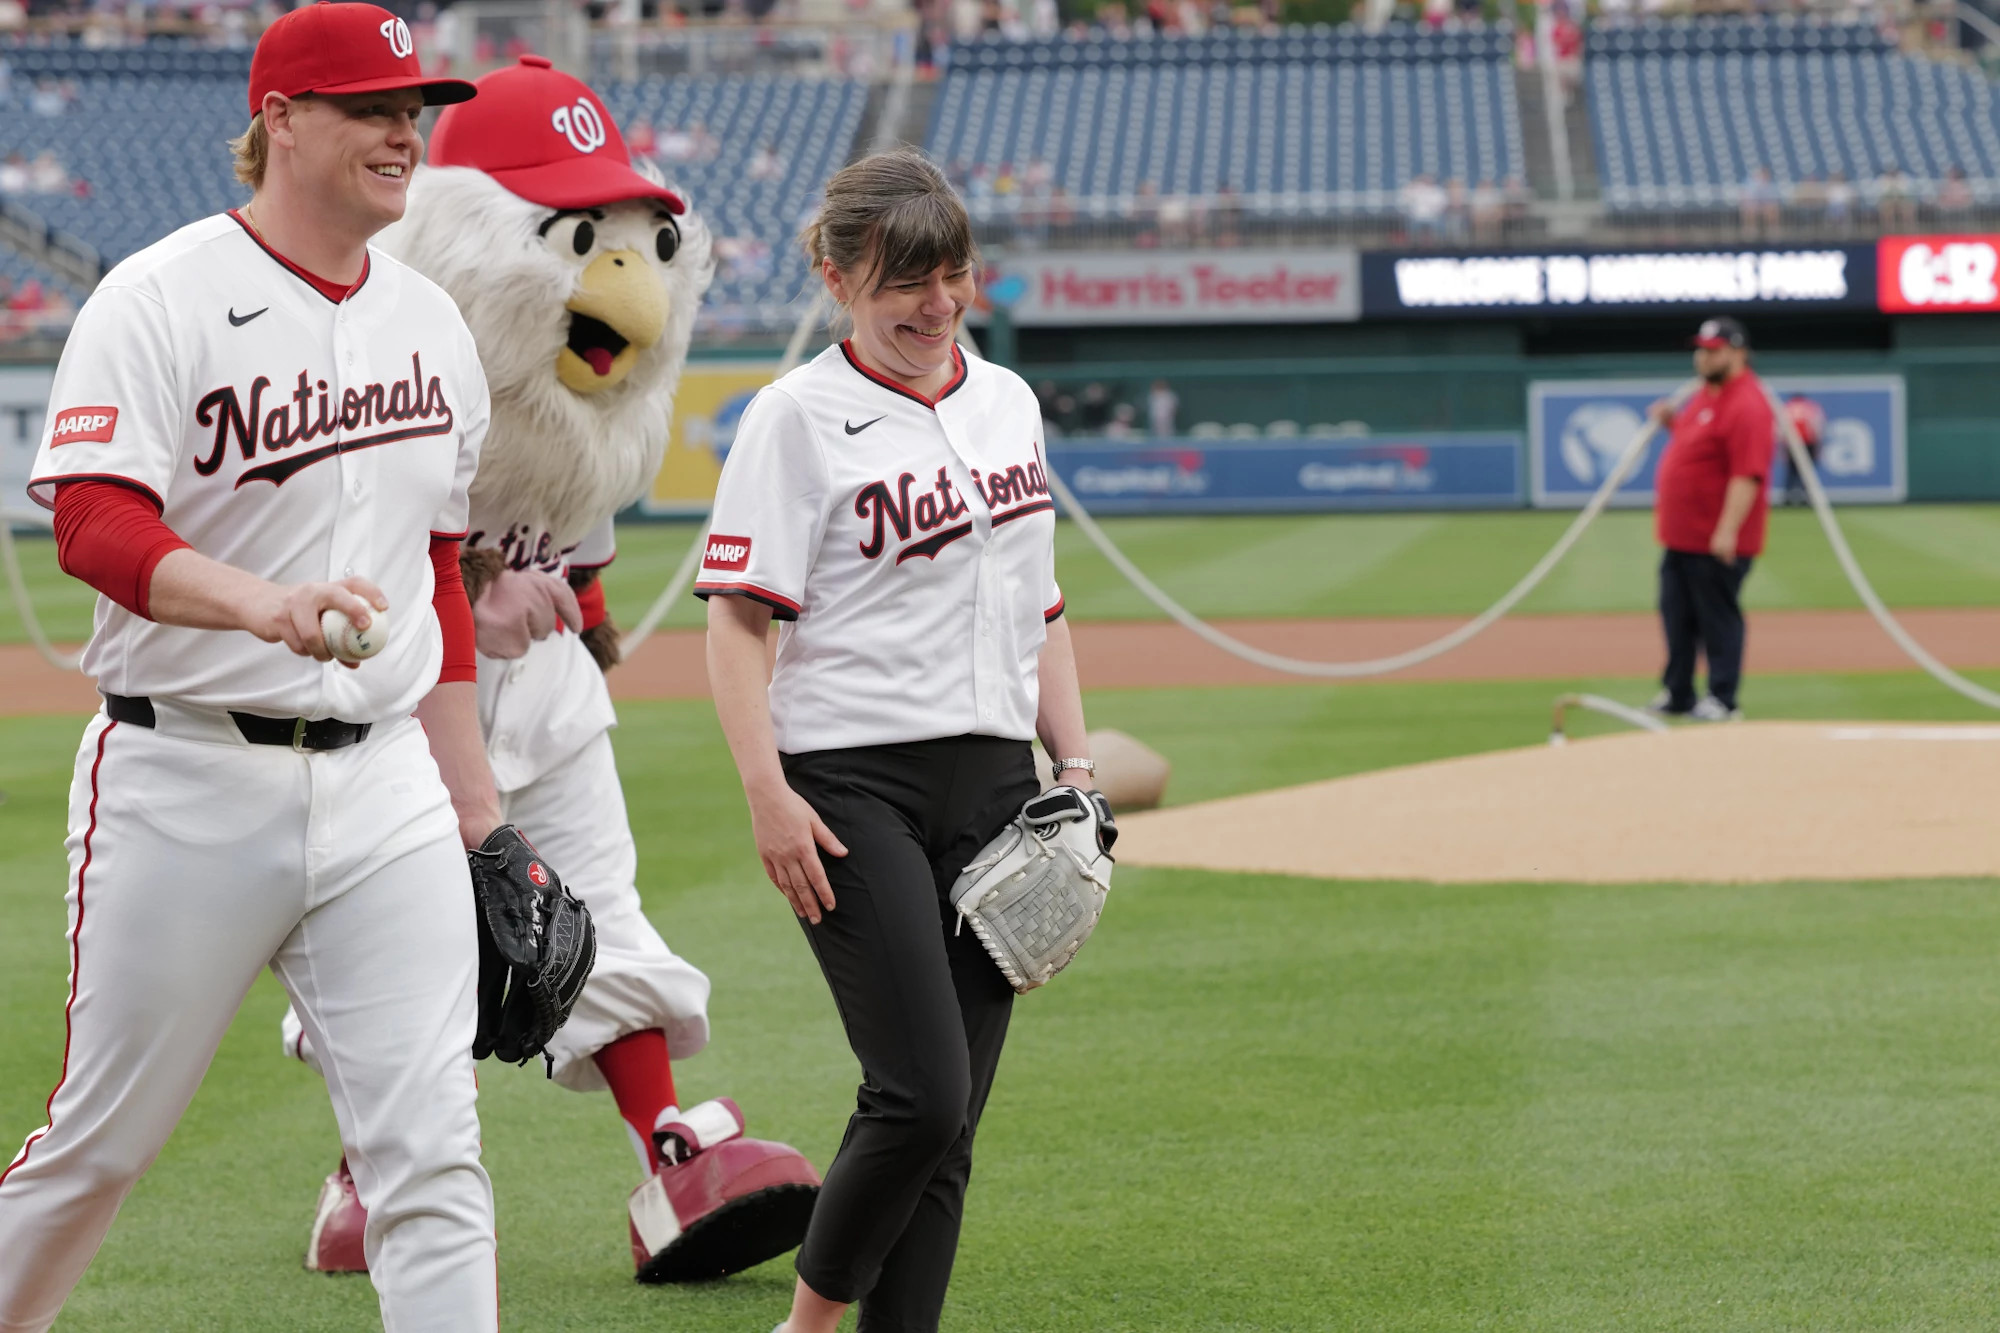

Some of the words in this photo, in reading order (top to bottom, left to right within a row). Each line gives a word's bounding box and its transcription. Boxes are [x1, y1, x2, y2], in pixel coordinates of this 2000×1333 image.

[380, 17, 413, 58] W
[552, 97, 606, 153] W
[1040, 268, 1184, 309] Harris
[54, 415, 109, 437] AARP
[194, 351, 452, 478] Nationals
[854, 441, 1049, 559] National
[706, 542, 746, 563] AARP
